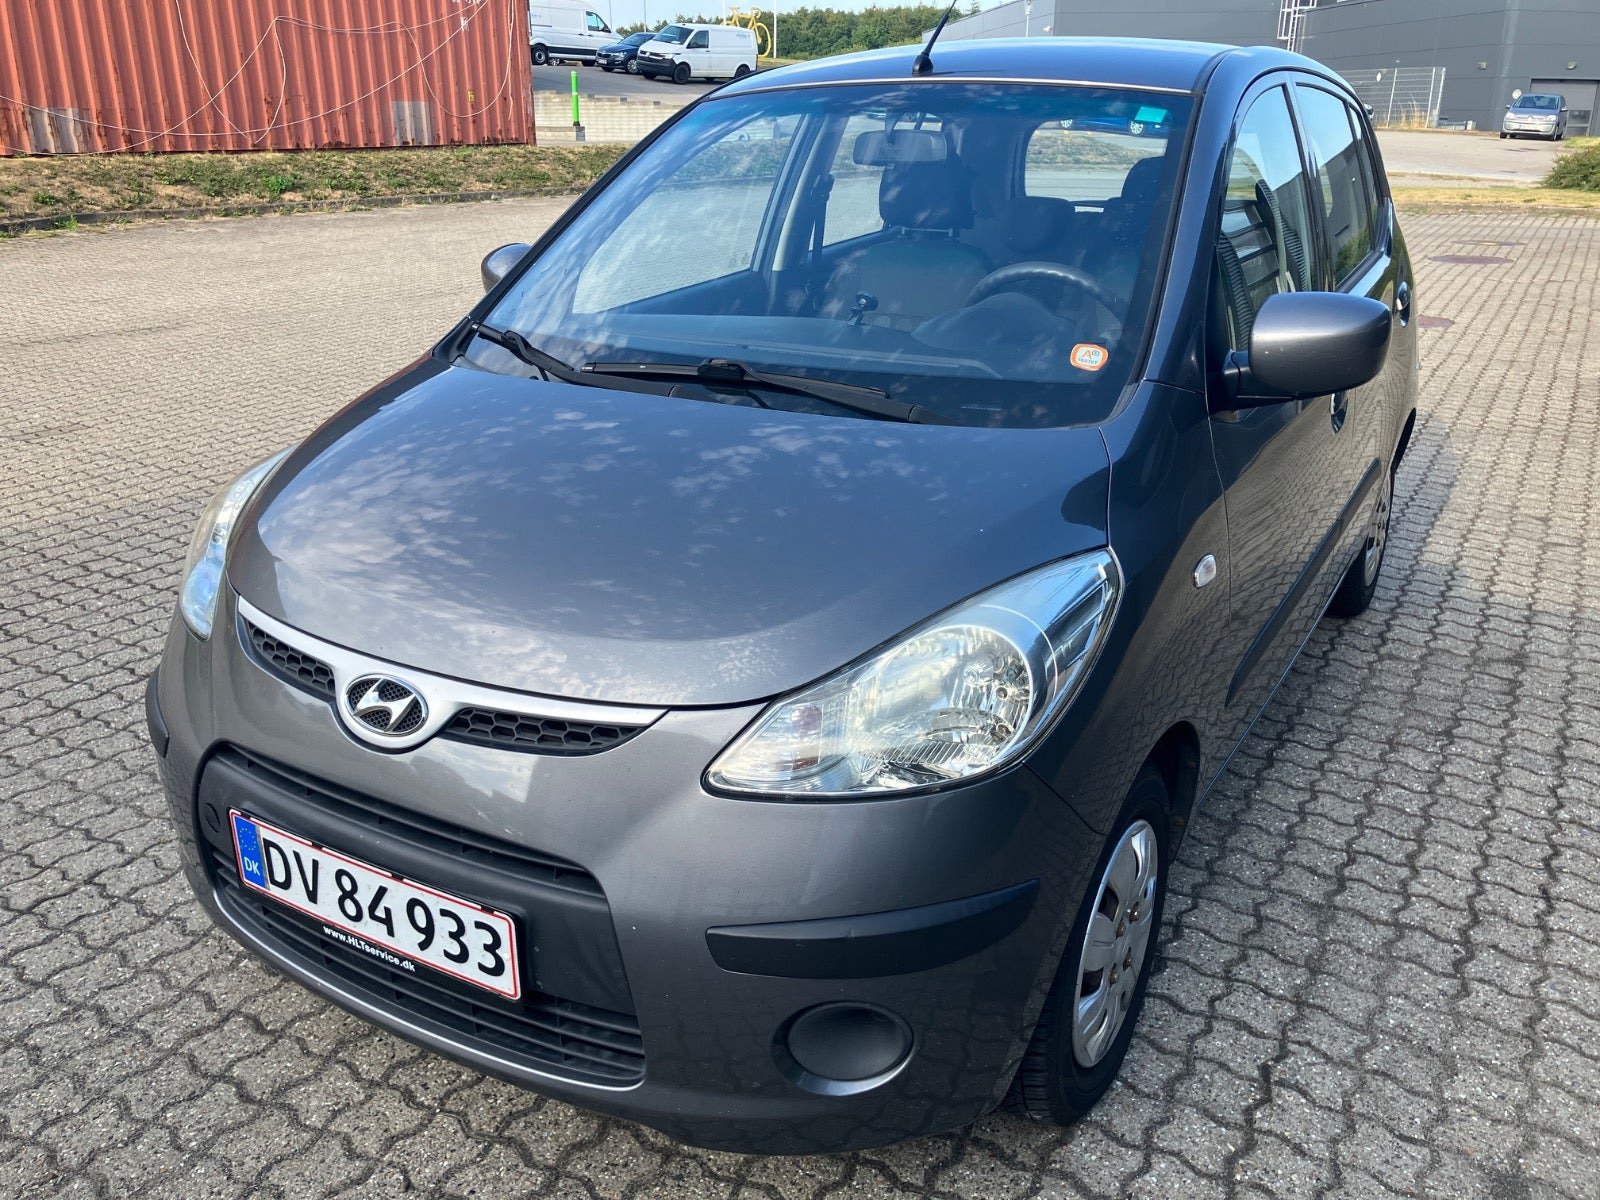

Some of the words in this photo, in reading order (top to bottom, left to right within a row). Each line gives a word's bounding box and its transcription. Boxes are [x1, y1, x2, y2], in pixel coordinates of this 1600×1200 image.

[244, 856, 260, 876] DK
[263, 838, 319, 905] DV
[323, 925, 416, 972] www.HLTservice.dk
